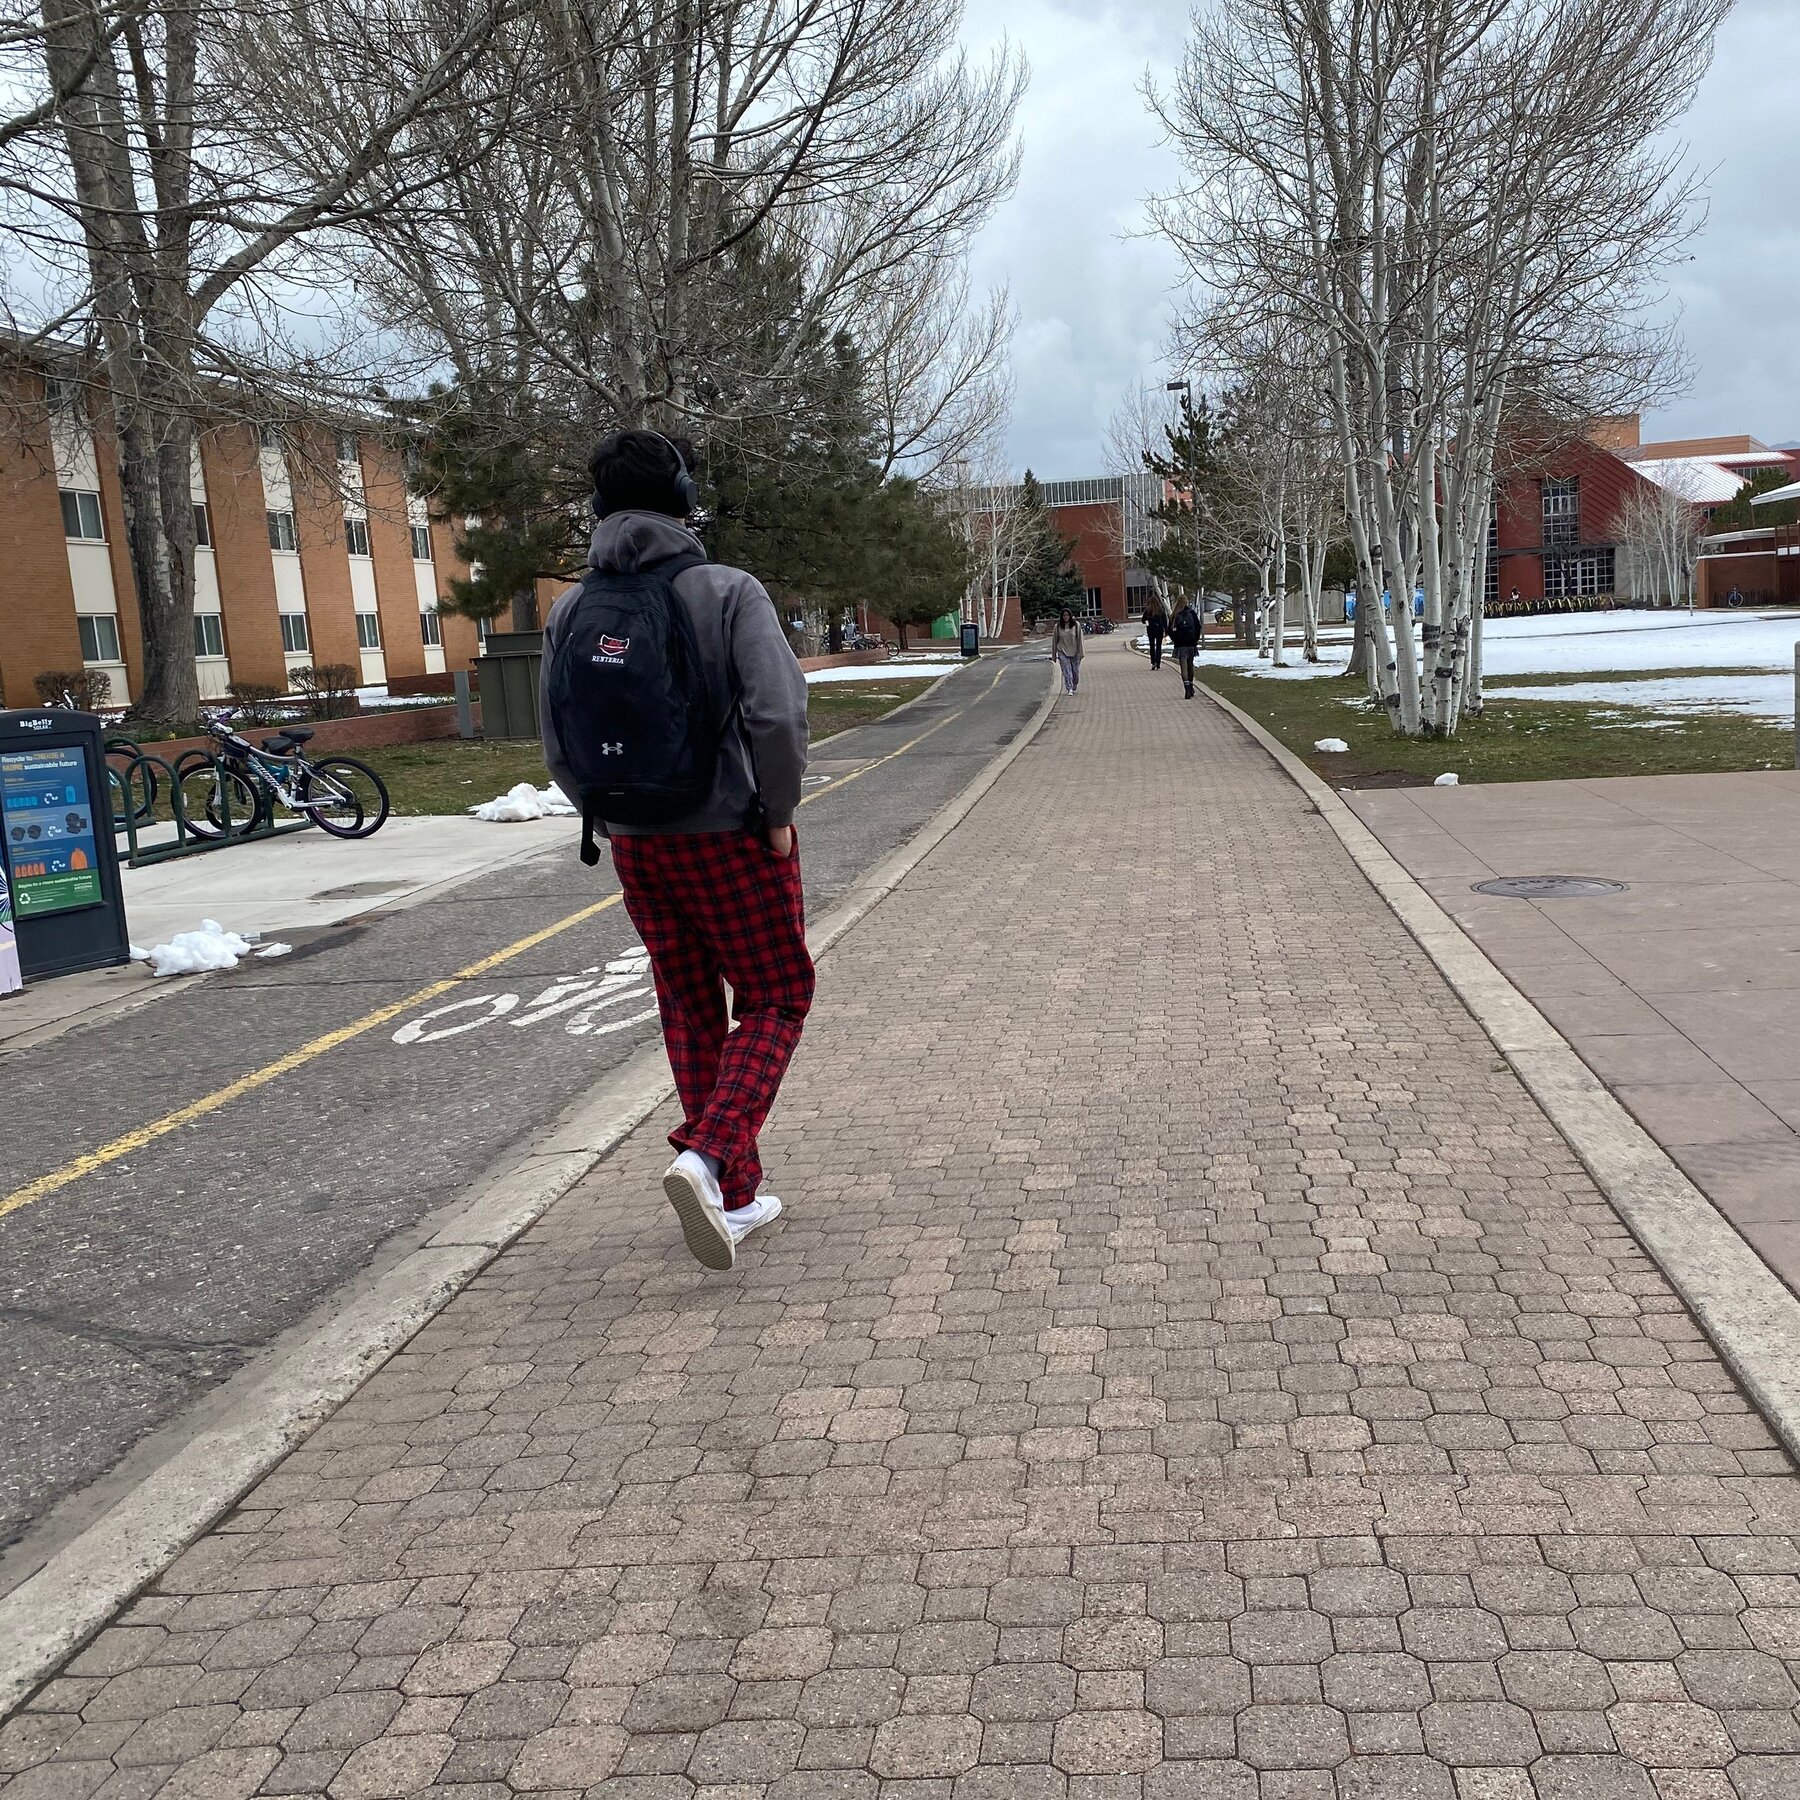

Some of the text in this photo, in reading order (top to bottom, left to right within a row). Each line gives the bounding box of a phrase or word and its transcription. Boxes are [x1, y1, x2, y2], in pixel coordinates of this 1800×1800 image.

[592, 655, 624, 664] RENTERIA
[19, 718, 53, 728] BigBelly
[1, 756, 25, 764] Recycle
[24, 762, 59, 770] sustainable
